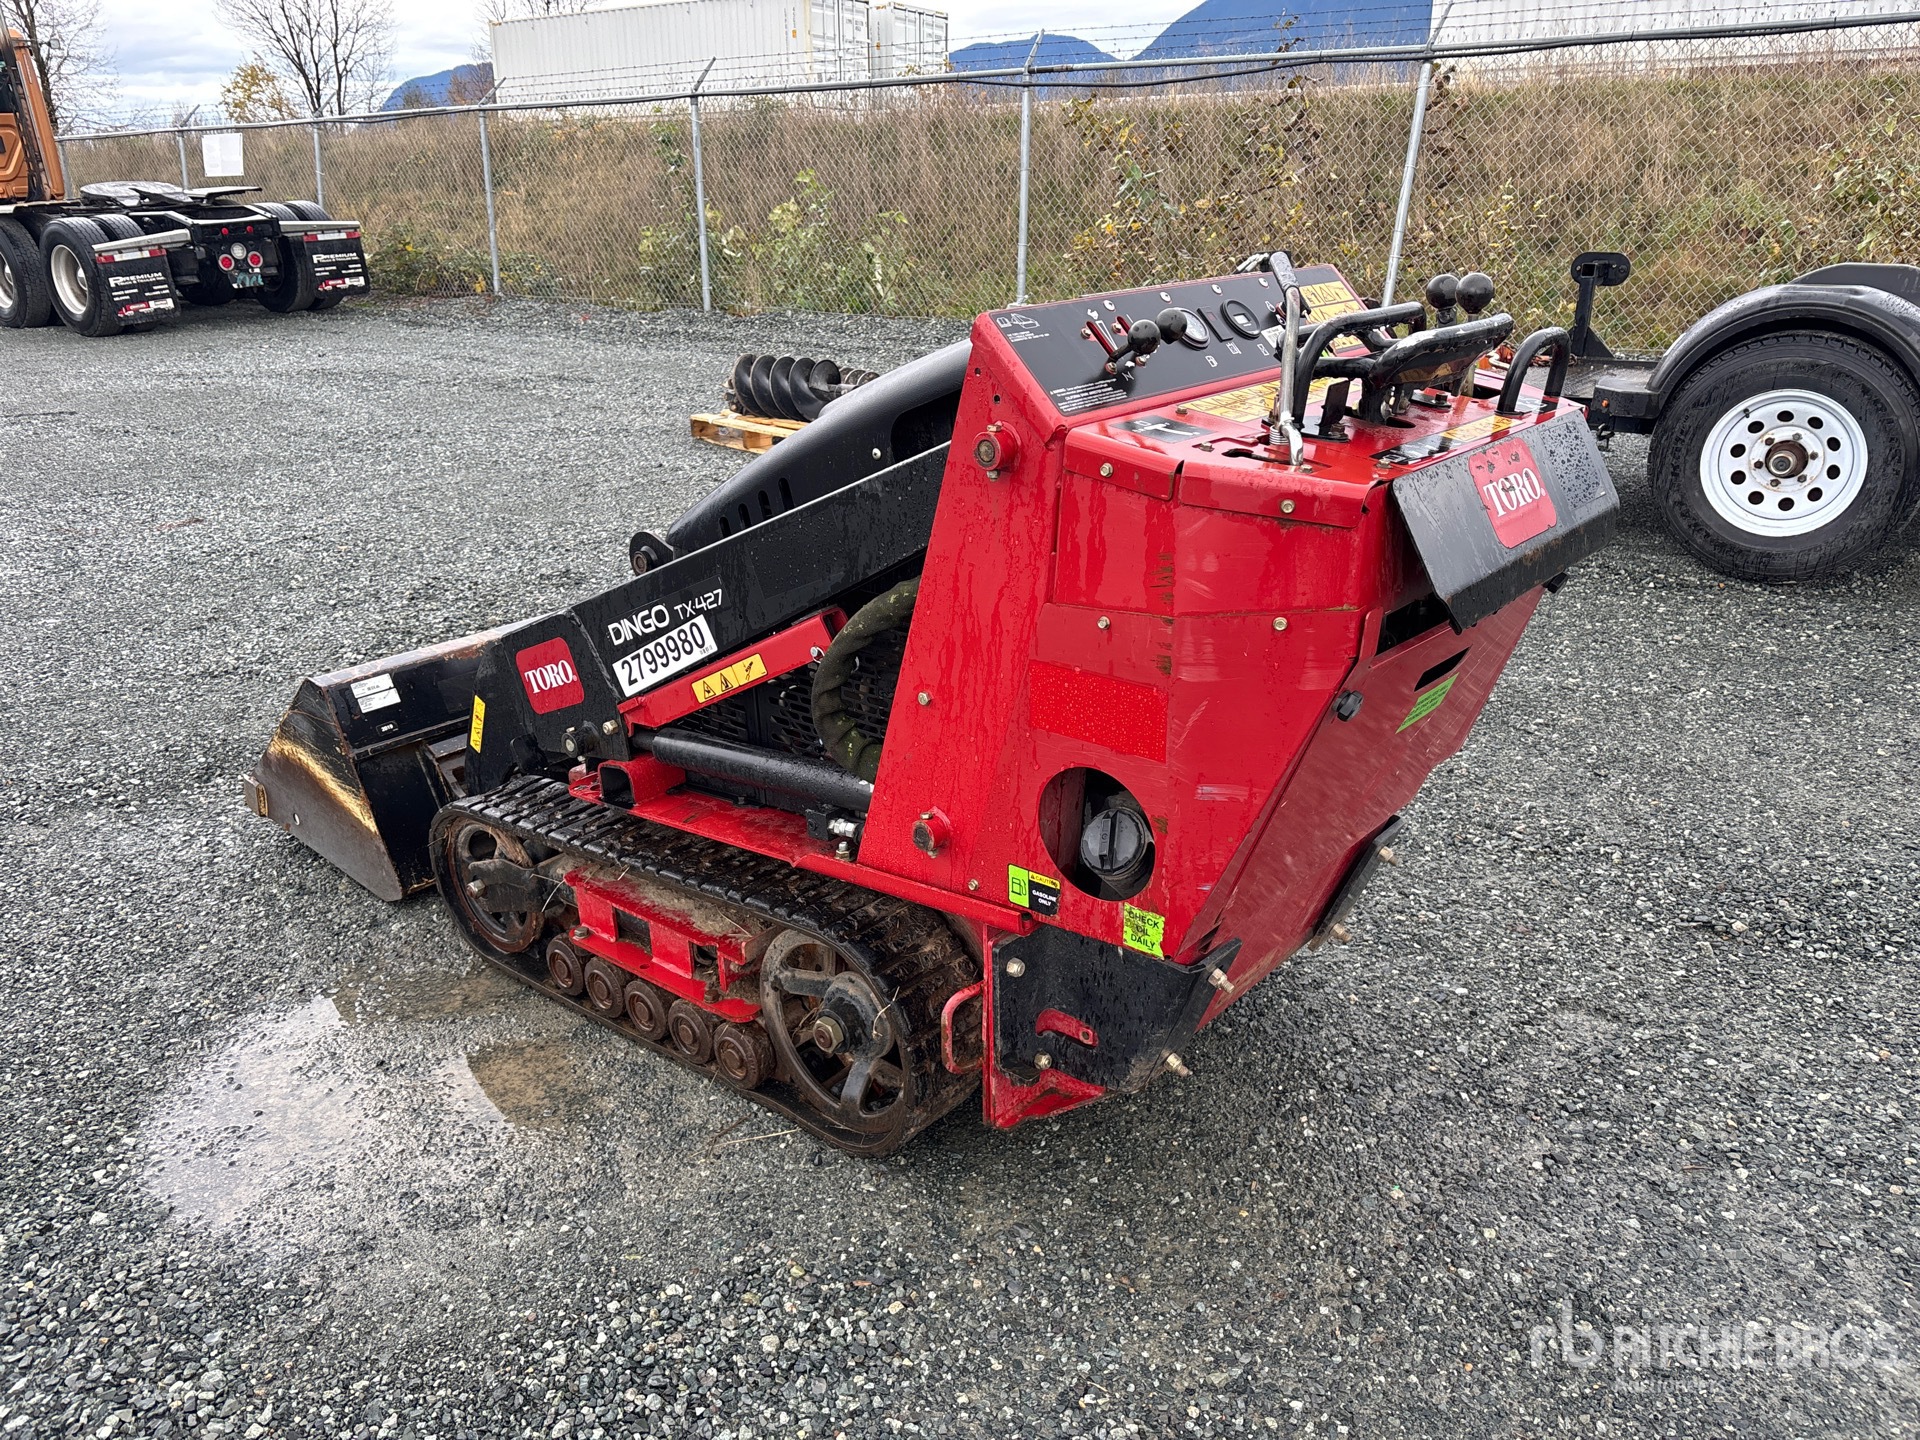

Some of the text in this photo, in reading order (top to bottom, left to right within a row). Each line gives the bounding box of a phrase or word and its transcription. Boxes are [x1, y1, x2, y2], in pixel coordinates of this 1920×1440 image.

[312, 253, 357, 263] PREMIUM
[108, 272, 162, 287] PREMIUM
[607, 604, 670, 646] DINGO
[621, 621, 706, 687] 2799980
[1032, 889, 1057, 902] GASOLINE
[1038, 898, 1052, 907] ONLY
[1128, 910, 1160, 930] CHECK
[1136, 924, 1151, 937] OIL
[1130, 933, 1156, 949] DAILY
